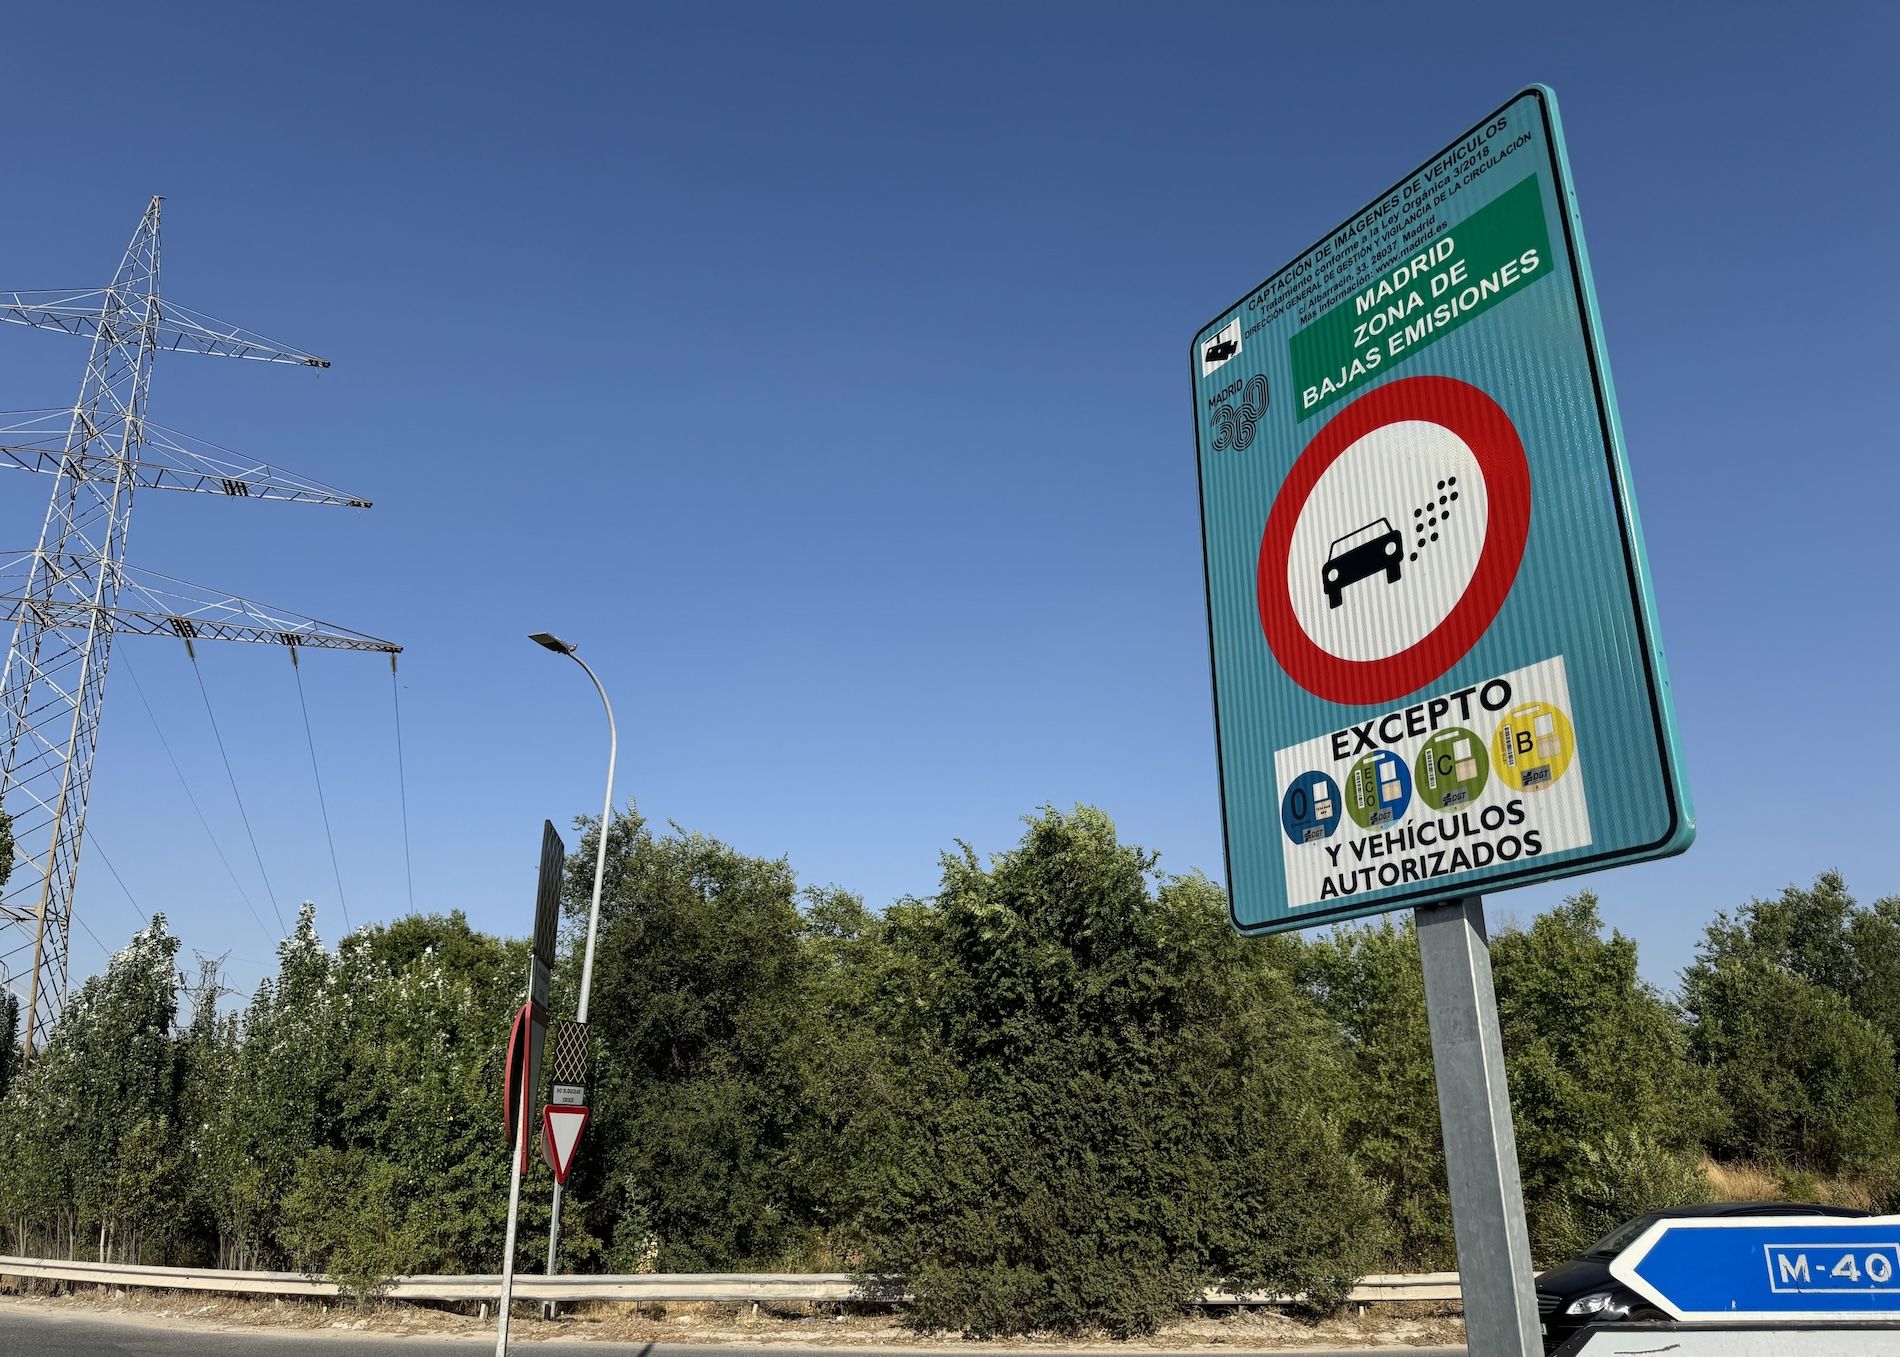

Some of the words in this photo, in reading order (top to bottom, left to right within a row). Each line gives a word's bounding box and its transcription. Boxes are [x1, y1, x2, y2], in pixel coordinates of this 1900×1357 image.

[1245, 306, 1284, 339] DIRECCIÓN
[1285, 283, 1322, 310] GENERAL
[1324, 272, 1335, 283] DE
[1336, 244, 1373, 274] GESTIÓN
[1373, 238, 1380, 247] Y
[1381, 204, 1432, 242] VIGILANCIA
[1433, 191, 1447, 206] DE
[1449, 182, 1462, 195] LA
[1463, 131, 1532, 185] CIRCULACIÓN
[1248, 259, 1312, 311] CAPTACIÓN
[1315, 244, 1332, 264] DE
[1334, 195, 1400, 250] IMÁGENES
[1403, 179, 1422, 199] DE
[1424, 117, 1507, 182] VEHÍCULOS
[1260, 274, 1312, 315] Tratamiento
[1314, 243, 1359, 276] conforme
[1361, 236, 1368, 244] a
[1370, 227, 1379, 238] la
[1381, 211, 1400, 229] Ley
[1402, 176, 1450, 214] Orgánica
[1453, 146, 1490, 178] 3/2018
[1371, 241, 1398, 264] 28037
[1402, 214, 1436, 243] Madrid
[1300, 311, 1317, 326] Más
[1375, 220, 1448, 274] www.madrid.es
[1353, 290, 1425, 348] ZONA
[1430, 259, 1469, 298] DE
[1355, 236, 1455, 316] MADRID
[1302, 346, 1382, 410] BAJAS
[1388, 248, 1540, 357] EMISIONES
[1208, 378, 1243, 410] MADRID
[1331, 678, 1512, 762] EXCEPTO
[1516, 730, 1533, 755] B
[1364, 767, 1376, 807] ECO
[1437, 754, 1453, 776] C
[1320, 829, 1543, 900] AUTORIZADOS
[1325, 843, 1342, 867] Y
[1348, 799, 1526, 861] VEHÍCULOS
[1777, 1252, 1893, 1283] M-40
